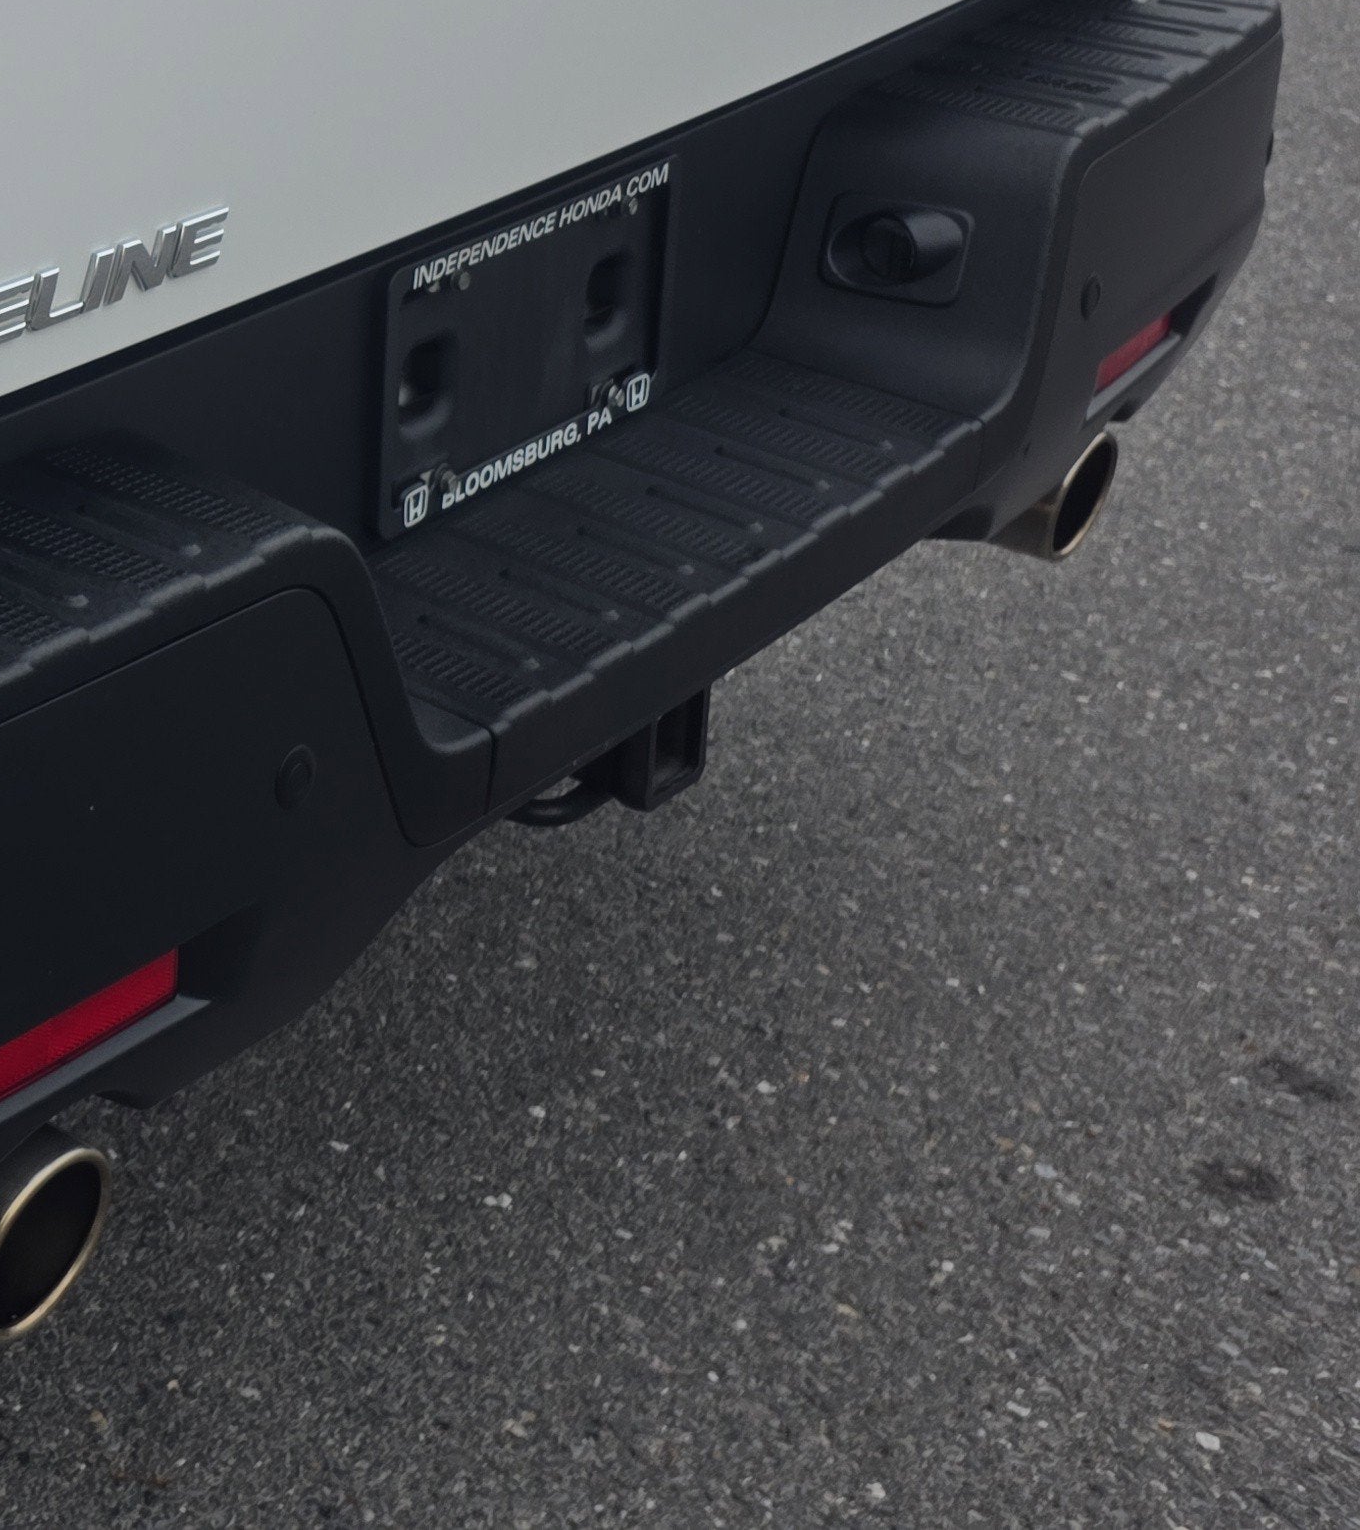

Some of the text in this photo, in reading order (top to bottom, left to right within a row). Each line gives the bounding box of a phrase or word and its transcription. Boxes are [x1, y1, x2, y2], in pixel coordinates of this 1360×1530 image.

[412, 211, 557, 290] INDEPENDENCE
[559, 183, 622, 228] HONDA
[587, 406, 613, 436] PA
